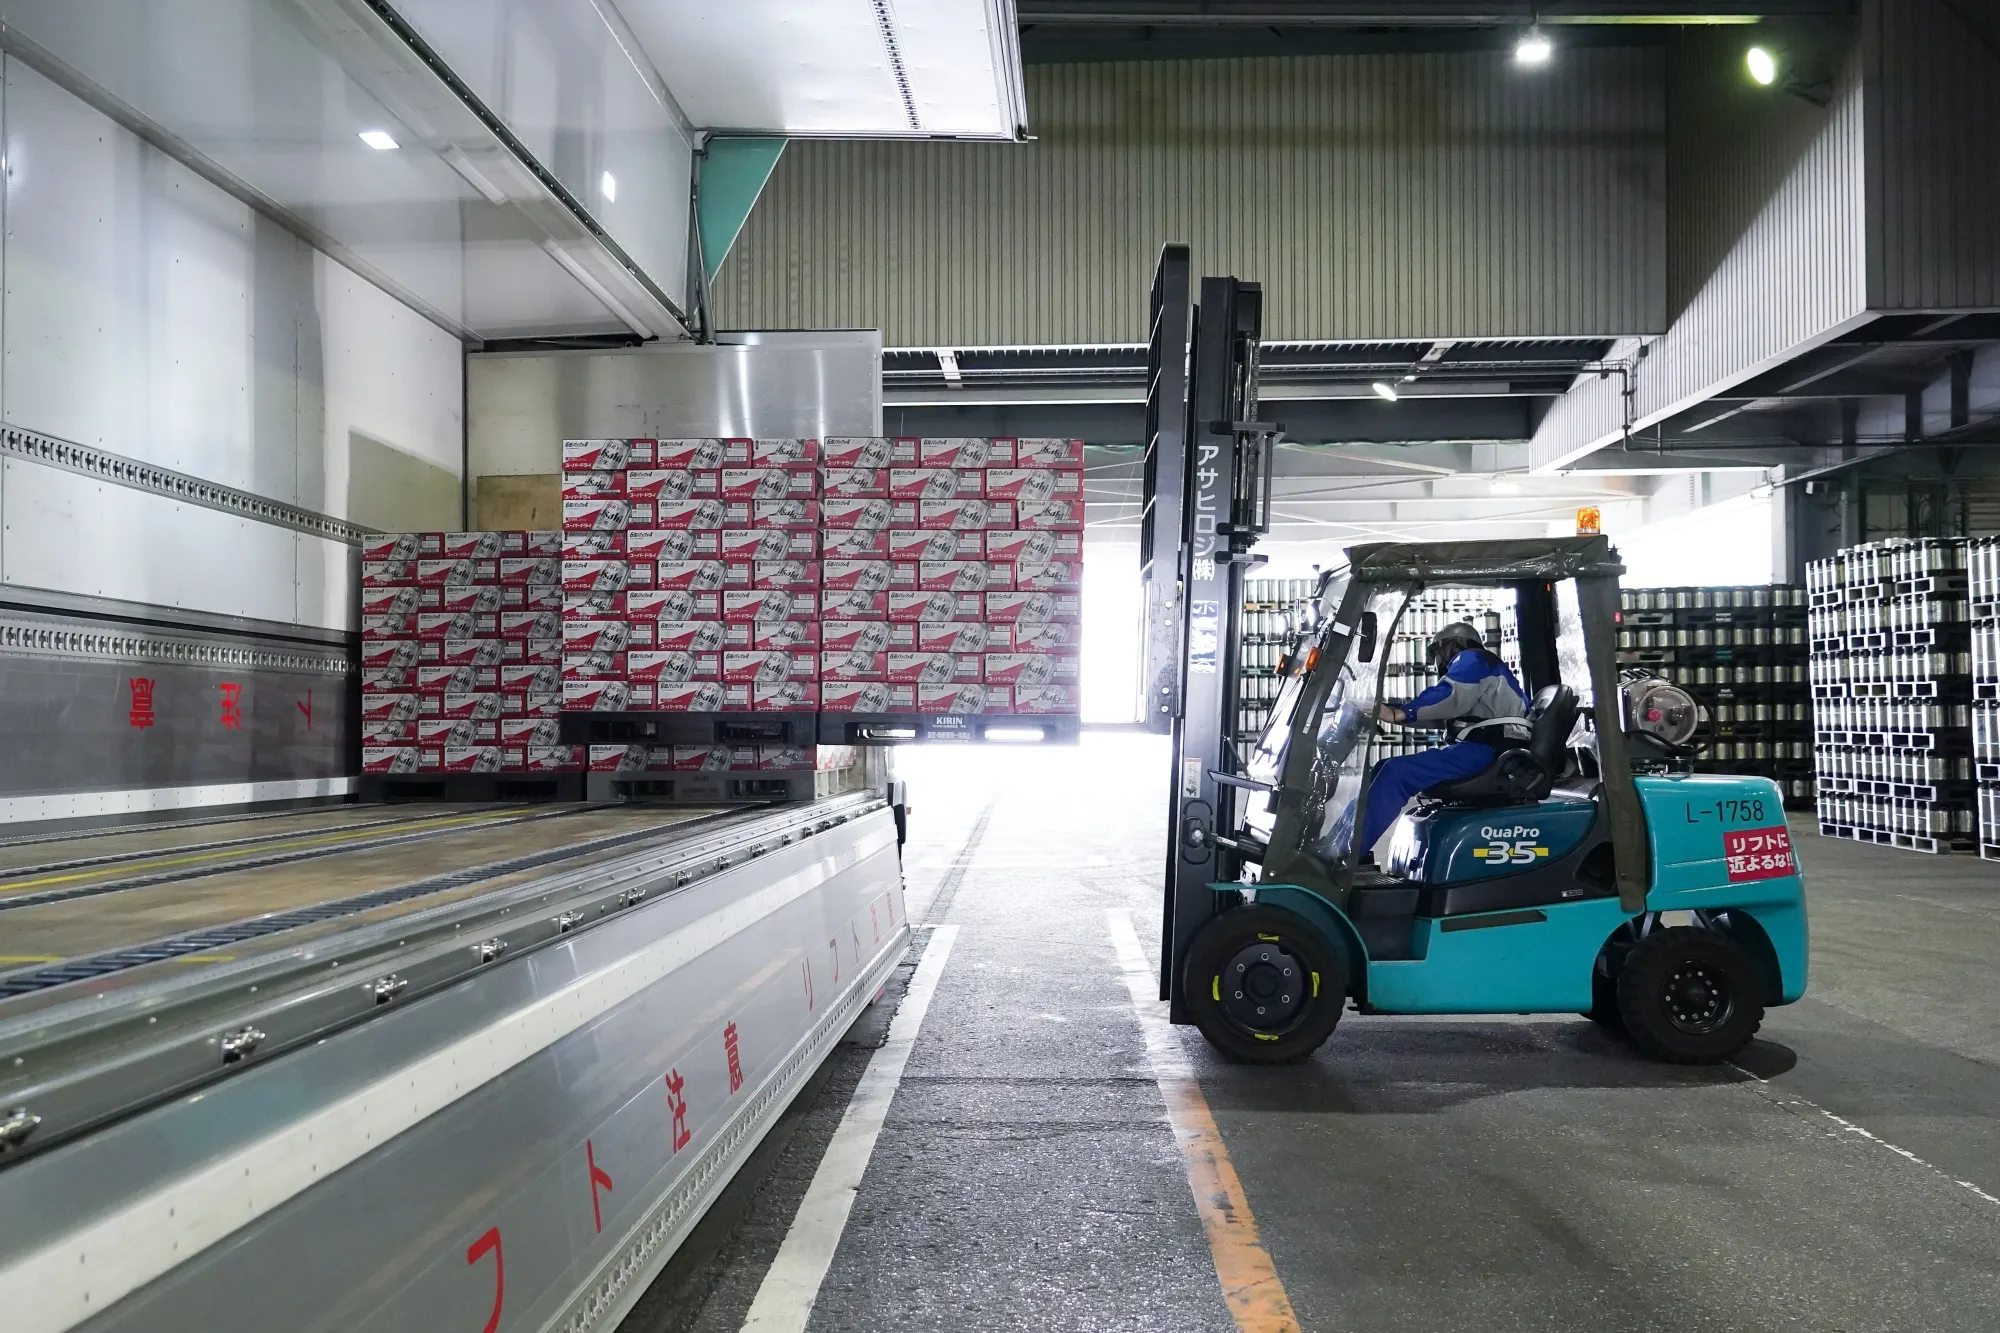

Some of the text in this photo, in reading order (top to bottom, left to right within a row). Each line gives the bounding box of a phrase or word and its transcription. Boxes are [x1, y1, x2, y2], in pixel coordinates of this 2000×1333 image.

[1686, 800, 1764, 823] L-1758
[1480, 826, 1540, 840] QuaPro
[1732, 833, 1789, 854] リフトに
[1484, 840, 1538, 864] 35
